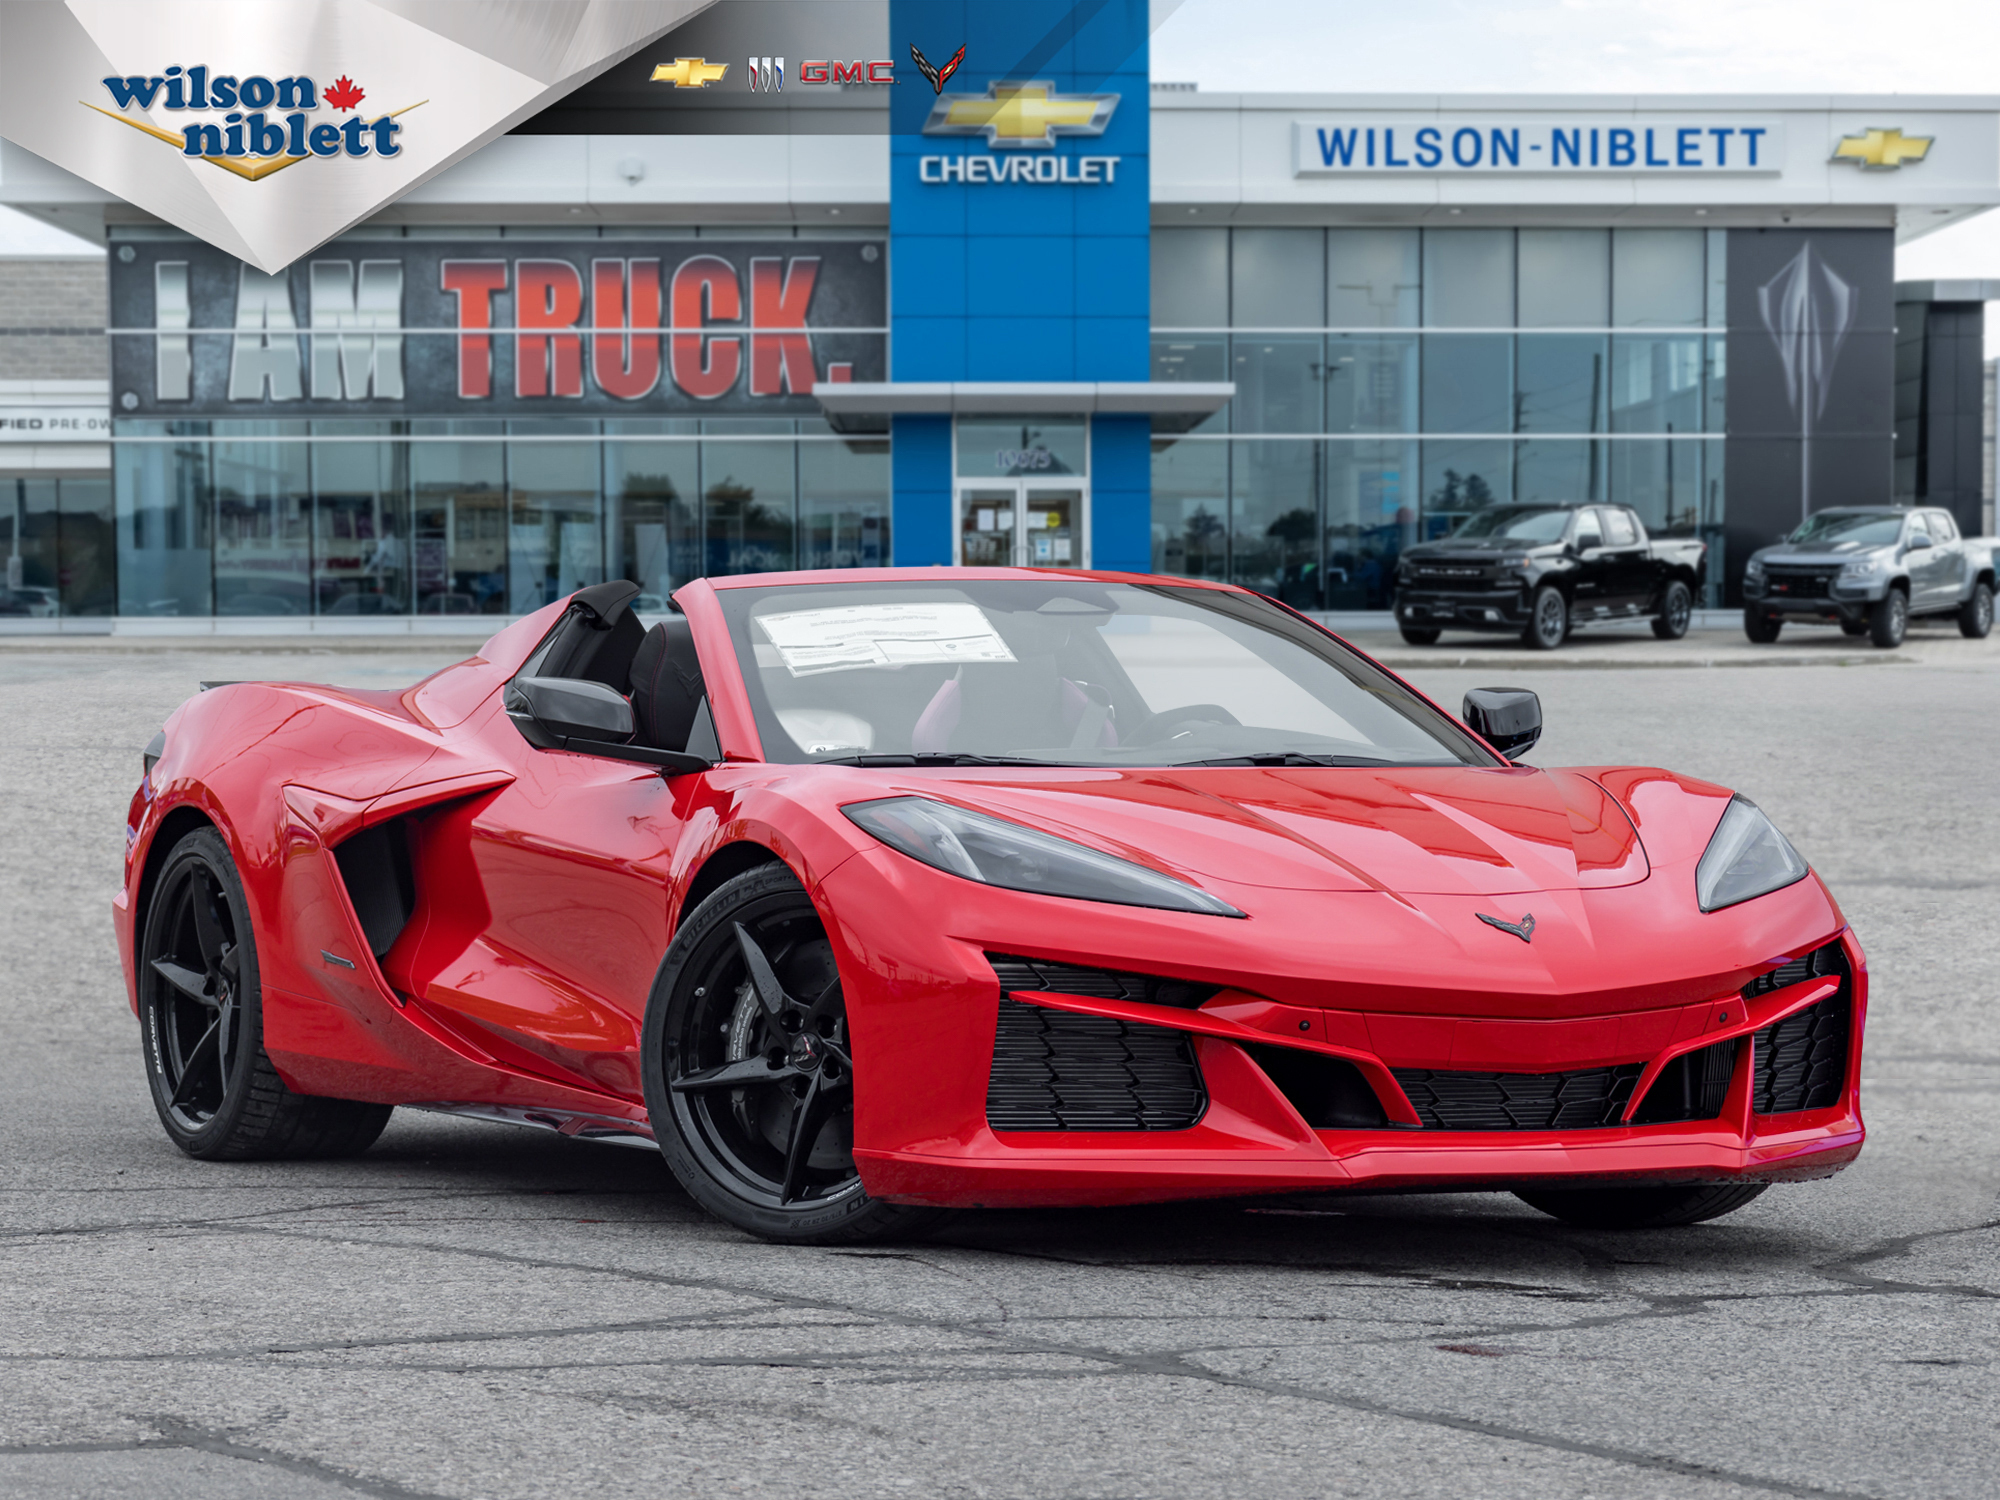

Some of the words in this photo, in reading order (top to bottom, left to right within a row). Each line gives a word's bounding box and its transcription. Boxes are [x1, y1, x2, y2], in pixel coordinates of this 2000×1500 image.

[919, 155, 1120, 184] CHEVROLET
[1316, 127, 1767, 168] WILSON-NIBLETT
[154, 260, 191, 401] I
[228, 258, 405, 401] AM
[440, 254, 853, 401] TRUCK.
[683, 892, 737, 948] MICHELIN
